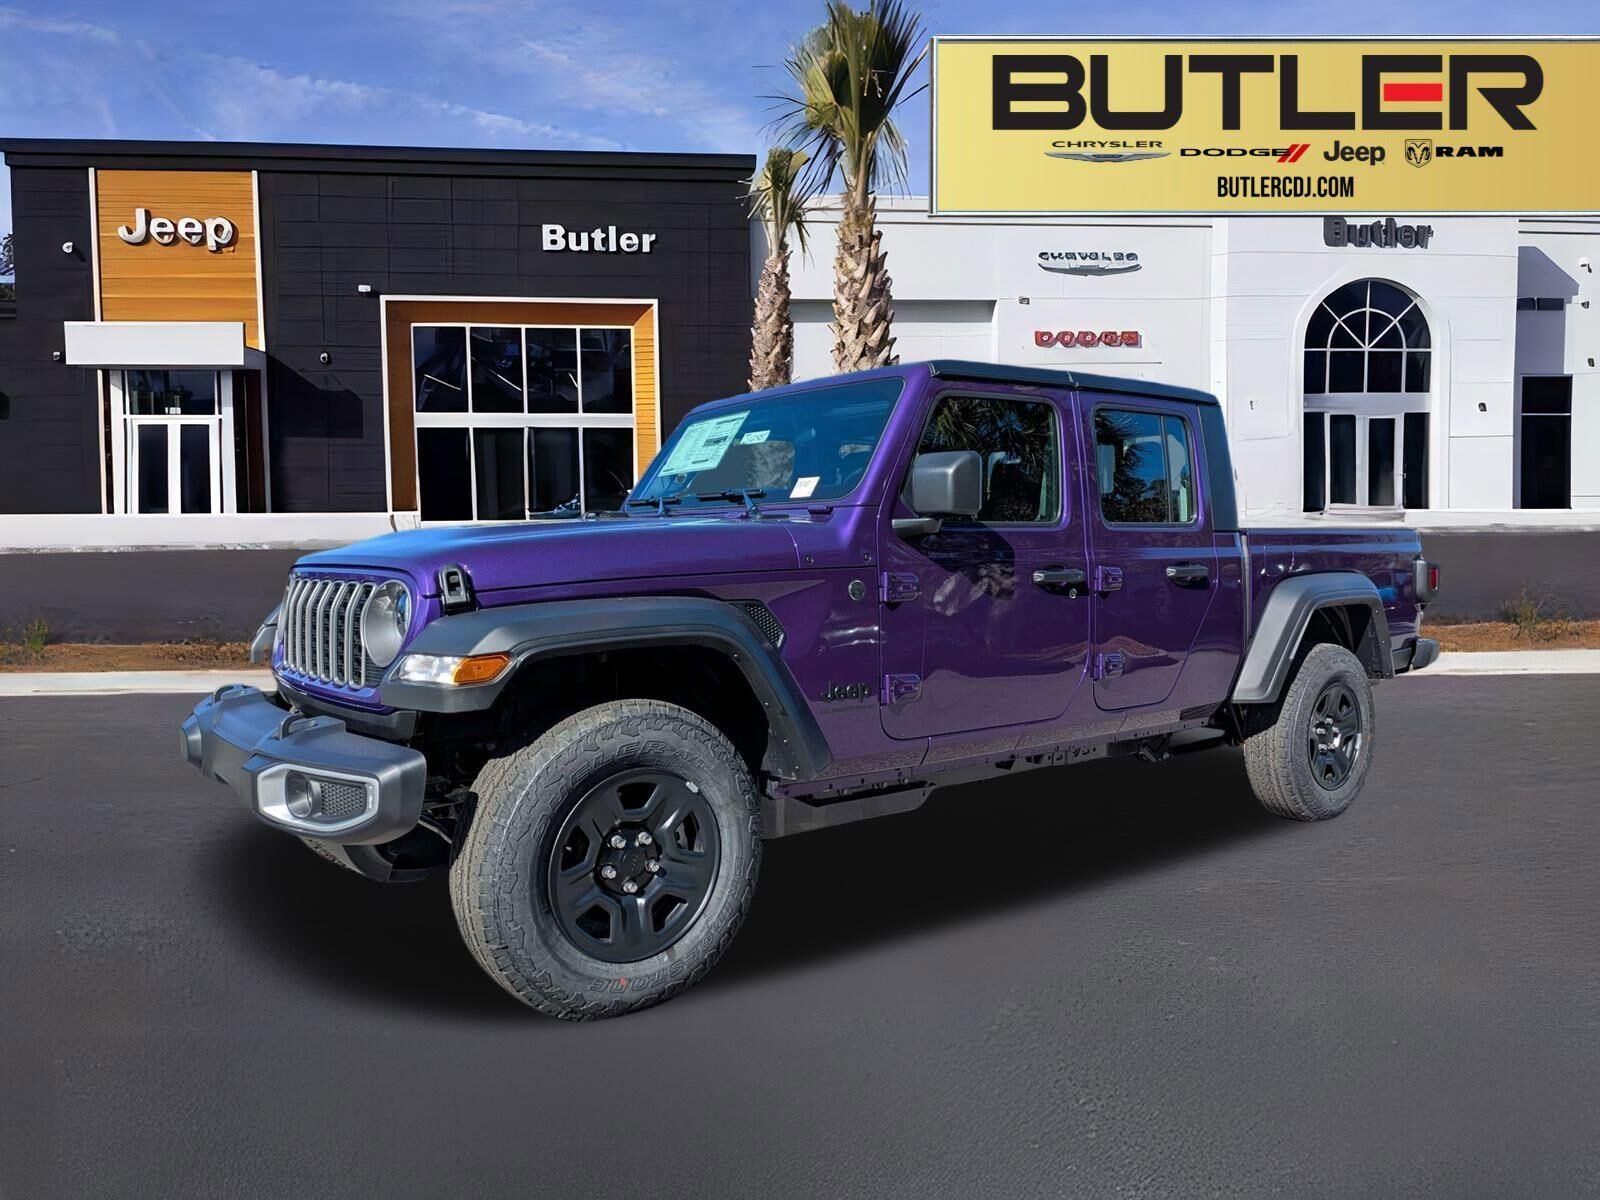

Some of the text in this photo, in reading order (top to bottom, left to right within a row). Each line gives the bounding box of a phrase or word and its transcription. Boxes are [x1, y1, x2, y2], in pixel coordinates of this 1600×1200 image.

[117, 208, 236, 252] Jeep
[541, 224, 657, 255] Butler
[1323, 216, 1434, 249] Butler
[820, 680, 872, 704] Jeep
